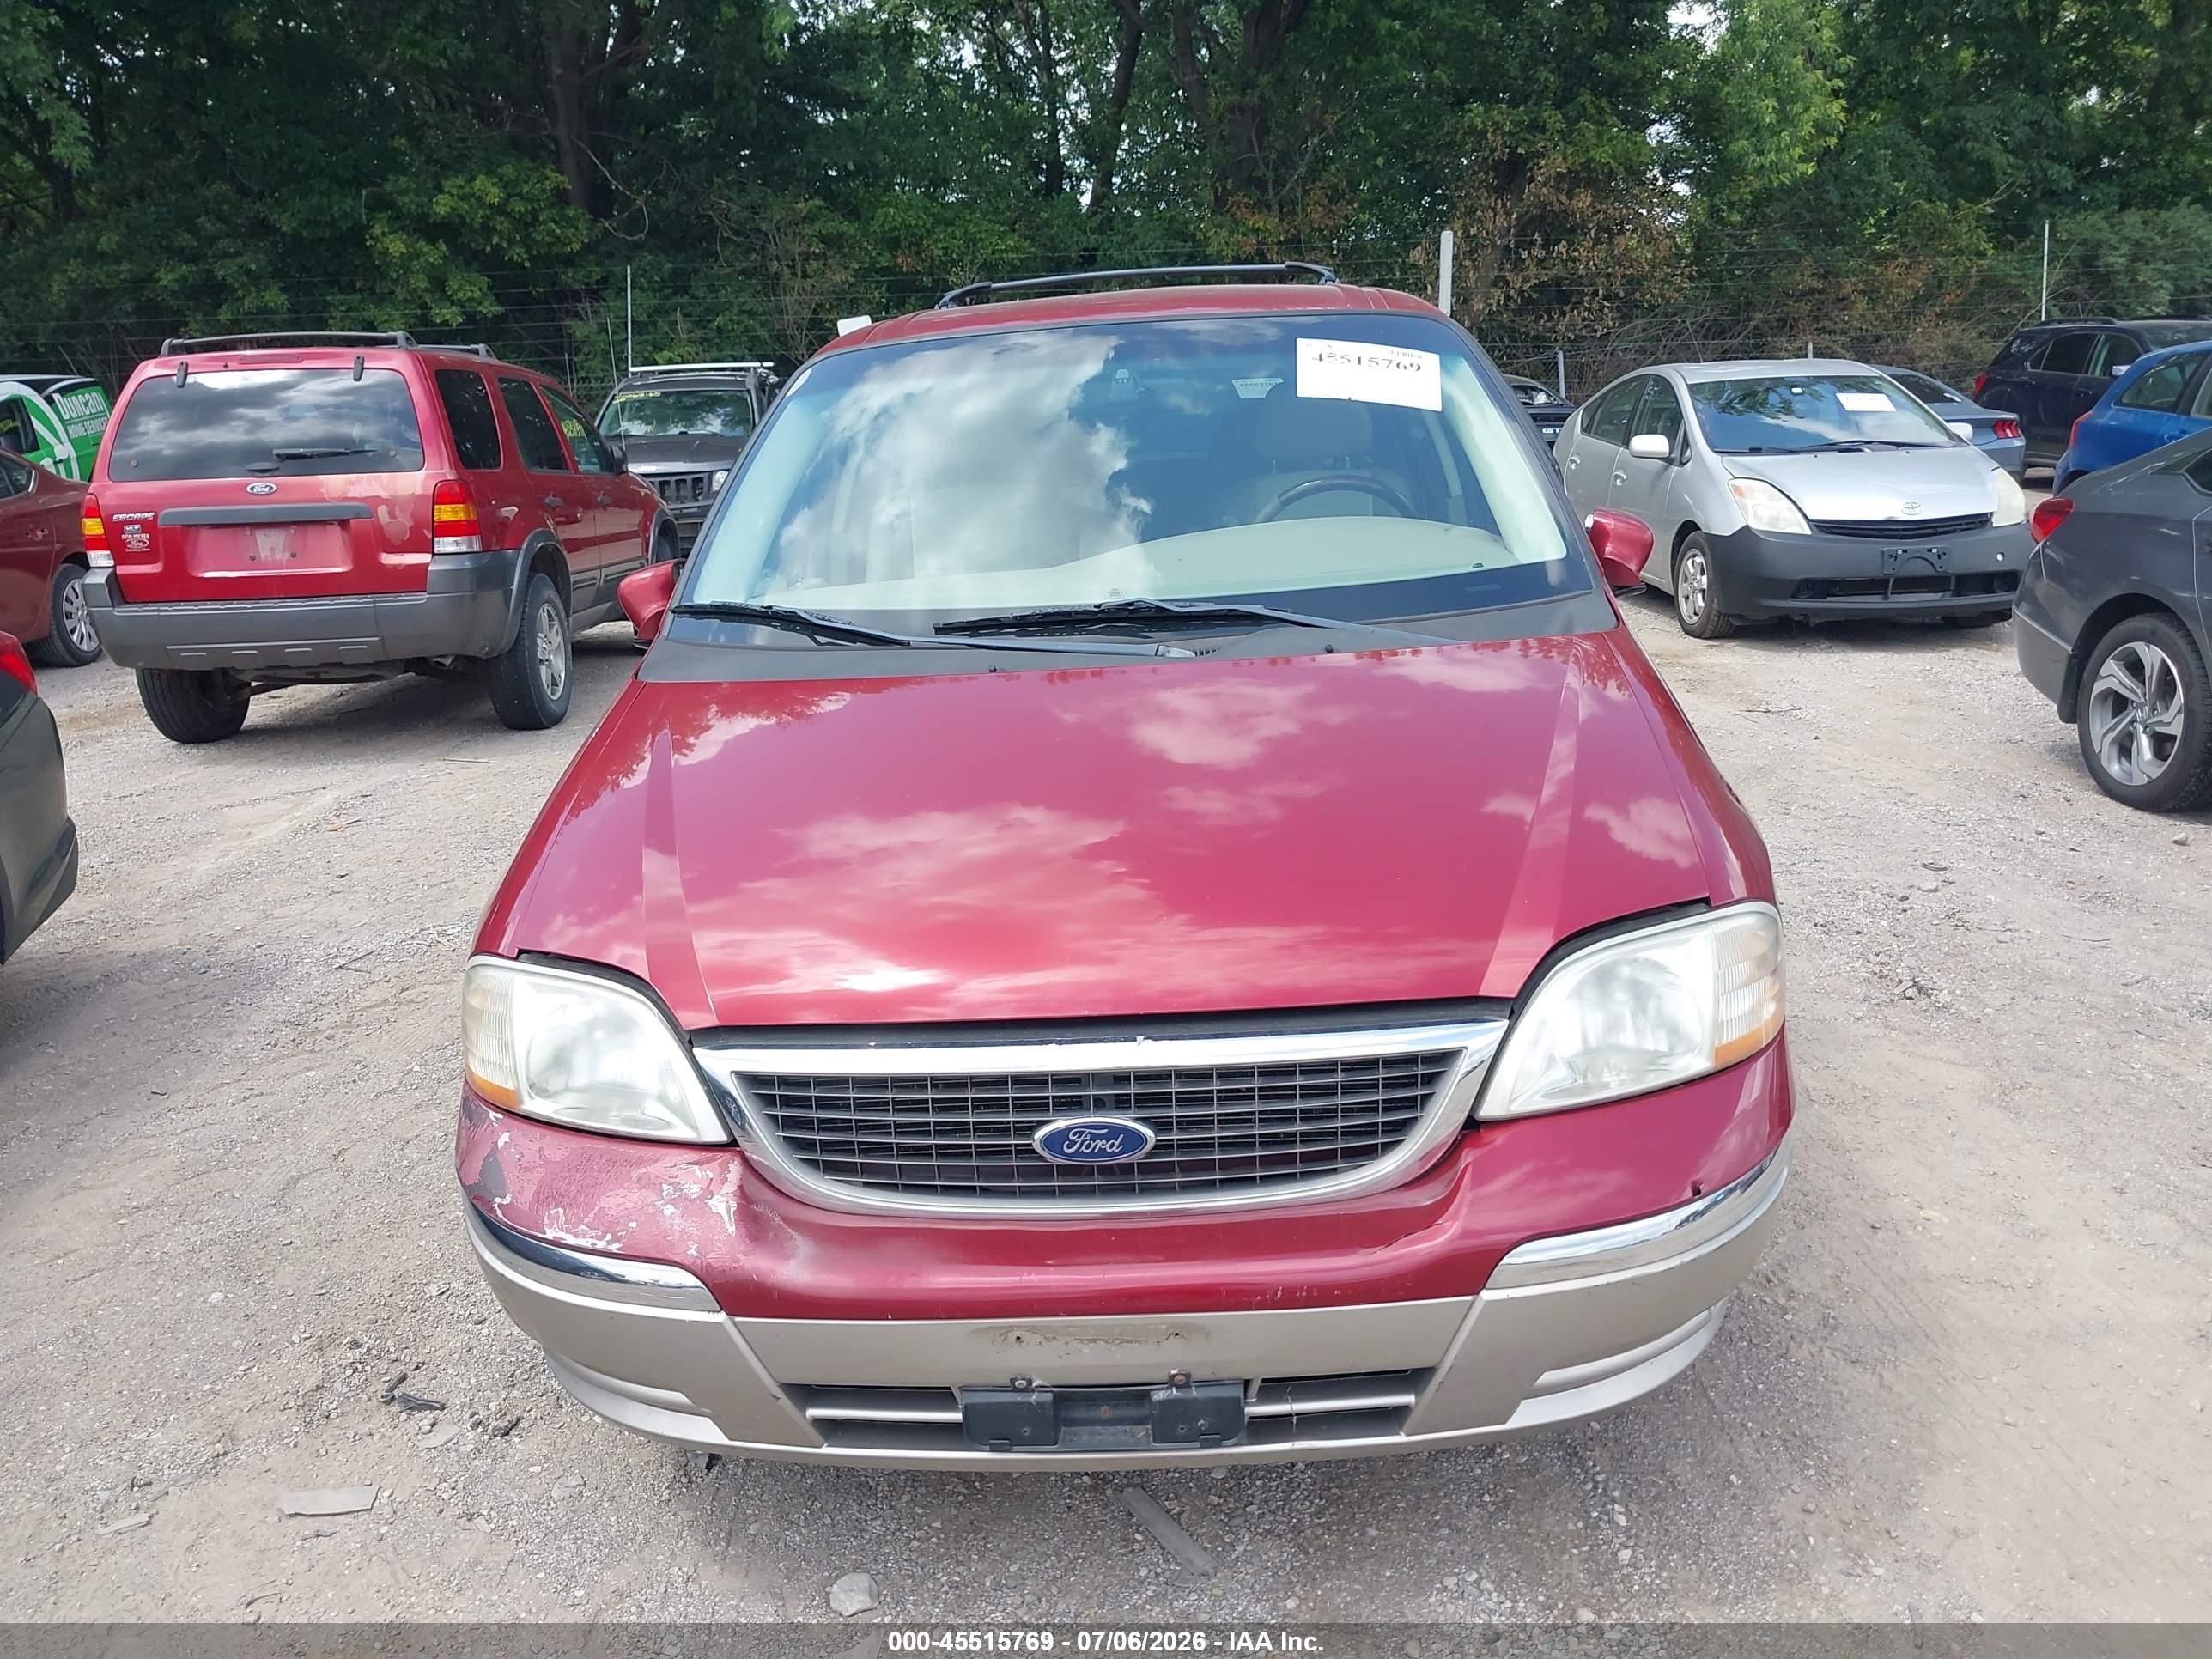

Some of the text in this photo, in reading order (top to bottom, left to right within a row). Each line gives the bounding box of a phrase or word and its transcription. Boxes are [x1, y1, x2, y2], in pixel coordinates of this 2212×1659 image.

[52, 392, 105, 420] Duncan
[67, 422, 87, 440] HOME
[112, 512, 155, 522] ESCAPE
[1063, 1127, 1124, 1154] Ford
